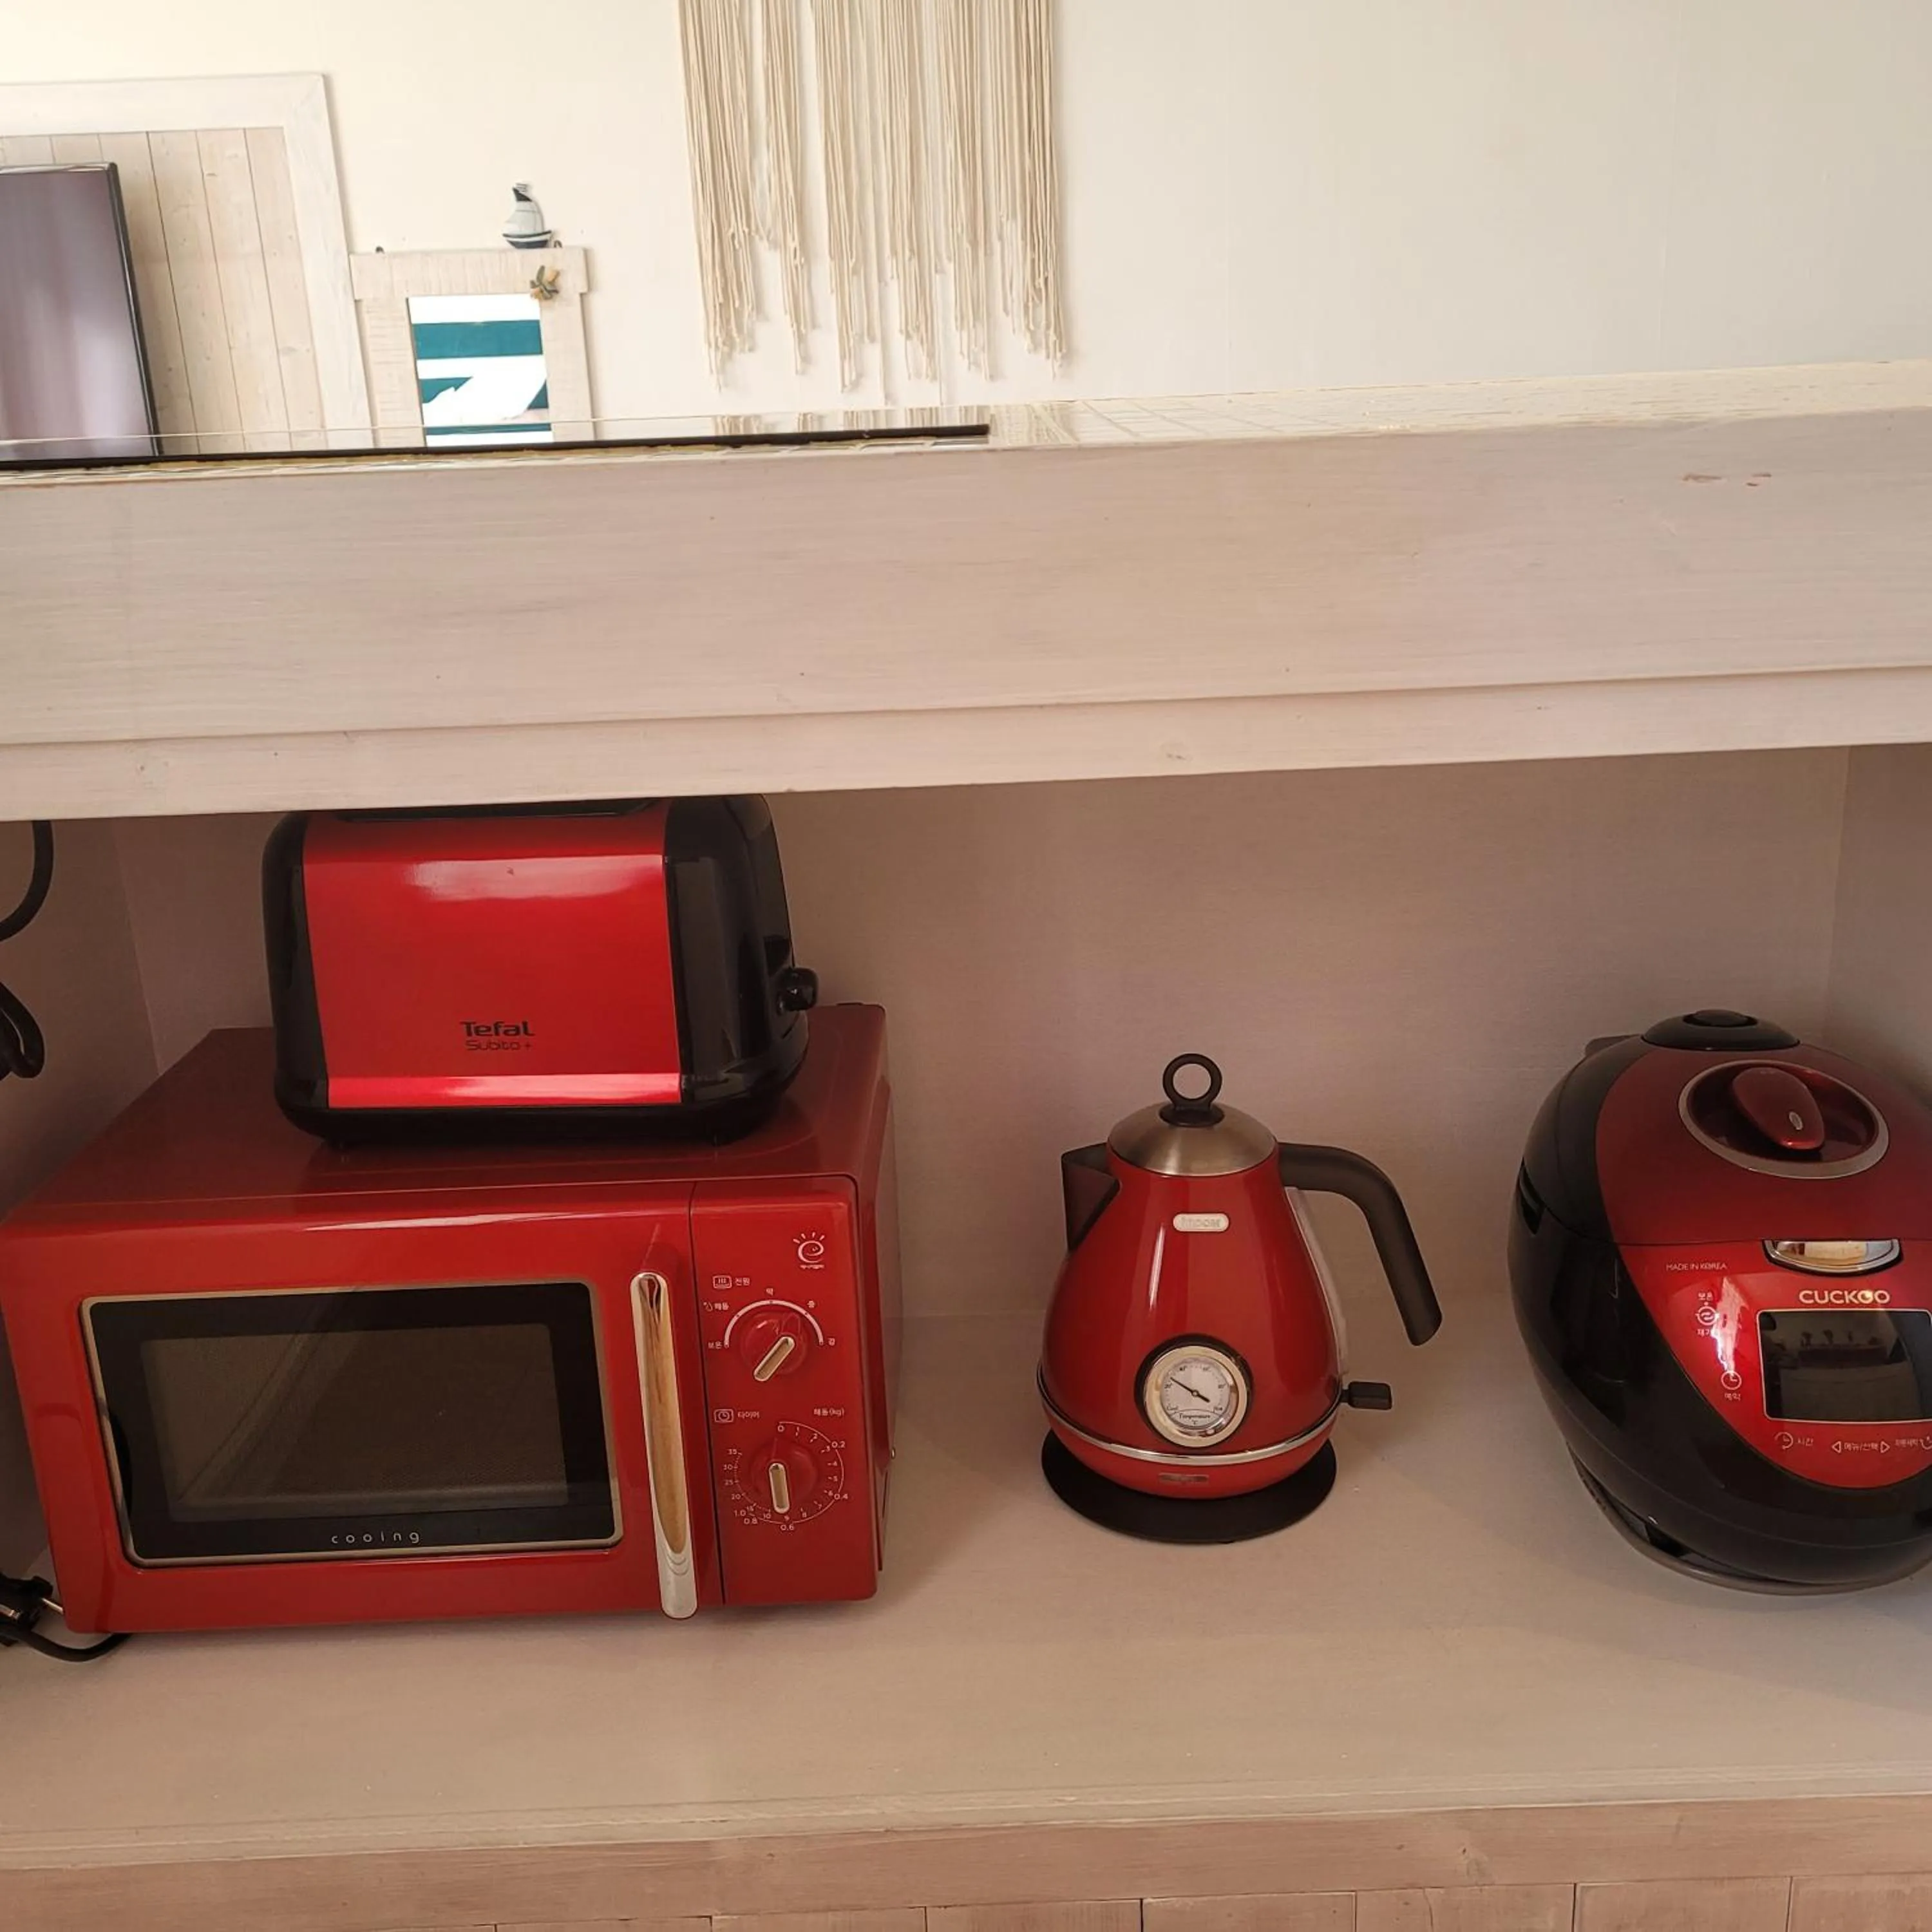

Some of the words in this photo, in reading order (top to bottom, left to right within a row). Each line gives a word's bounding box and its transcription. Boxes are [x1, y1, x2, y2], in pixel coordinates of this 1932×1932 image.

[459, 1020, 535, 1037] Tefal
[1799, 1289, 1891, 1304] CUCKOO
[831, 1441, 846, 1449] 0.2
[780, 1523, 795, 1531] 0.6
[332, 1530, 419, 1544] cooing
